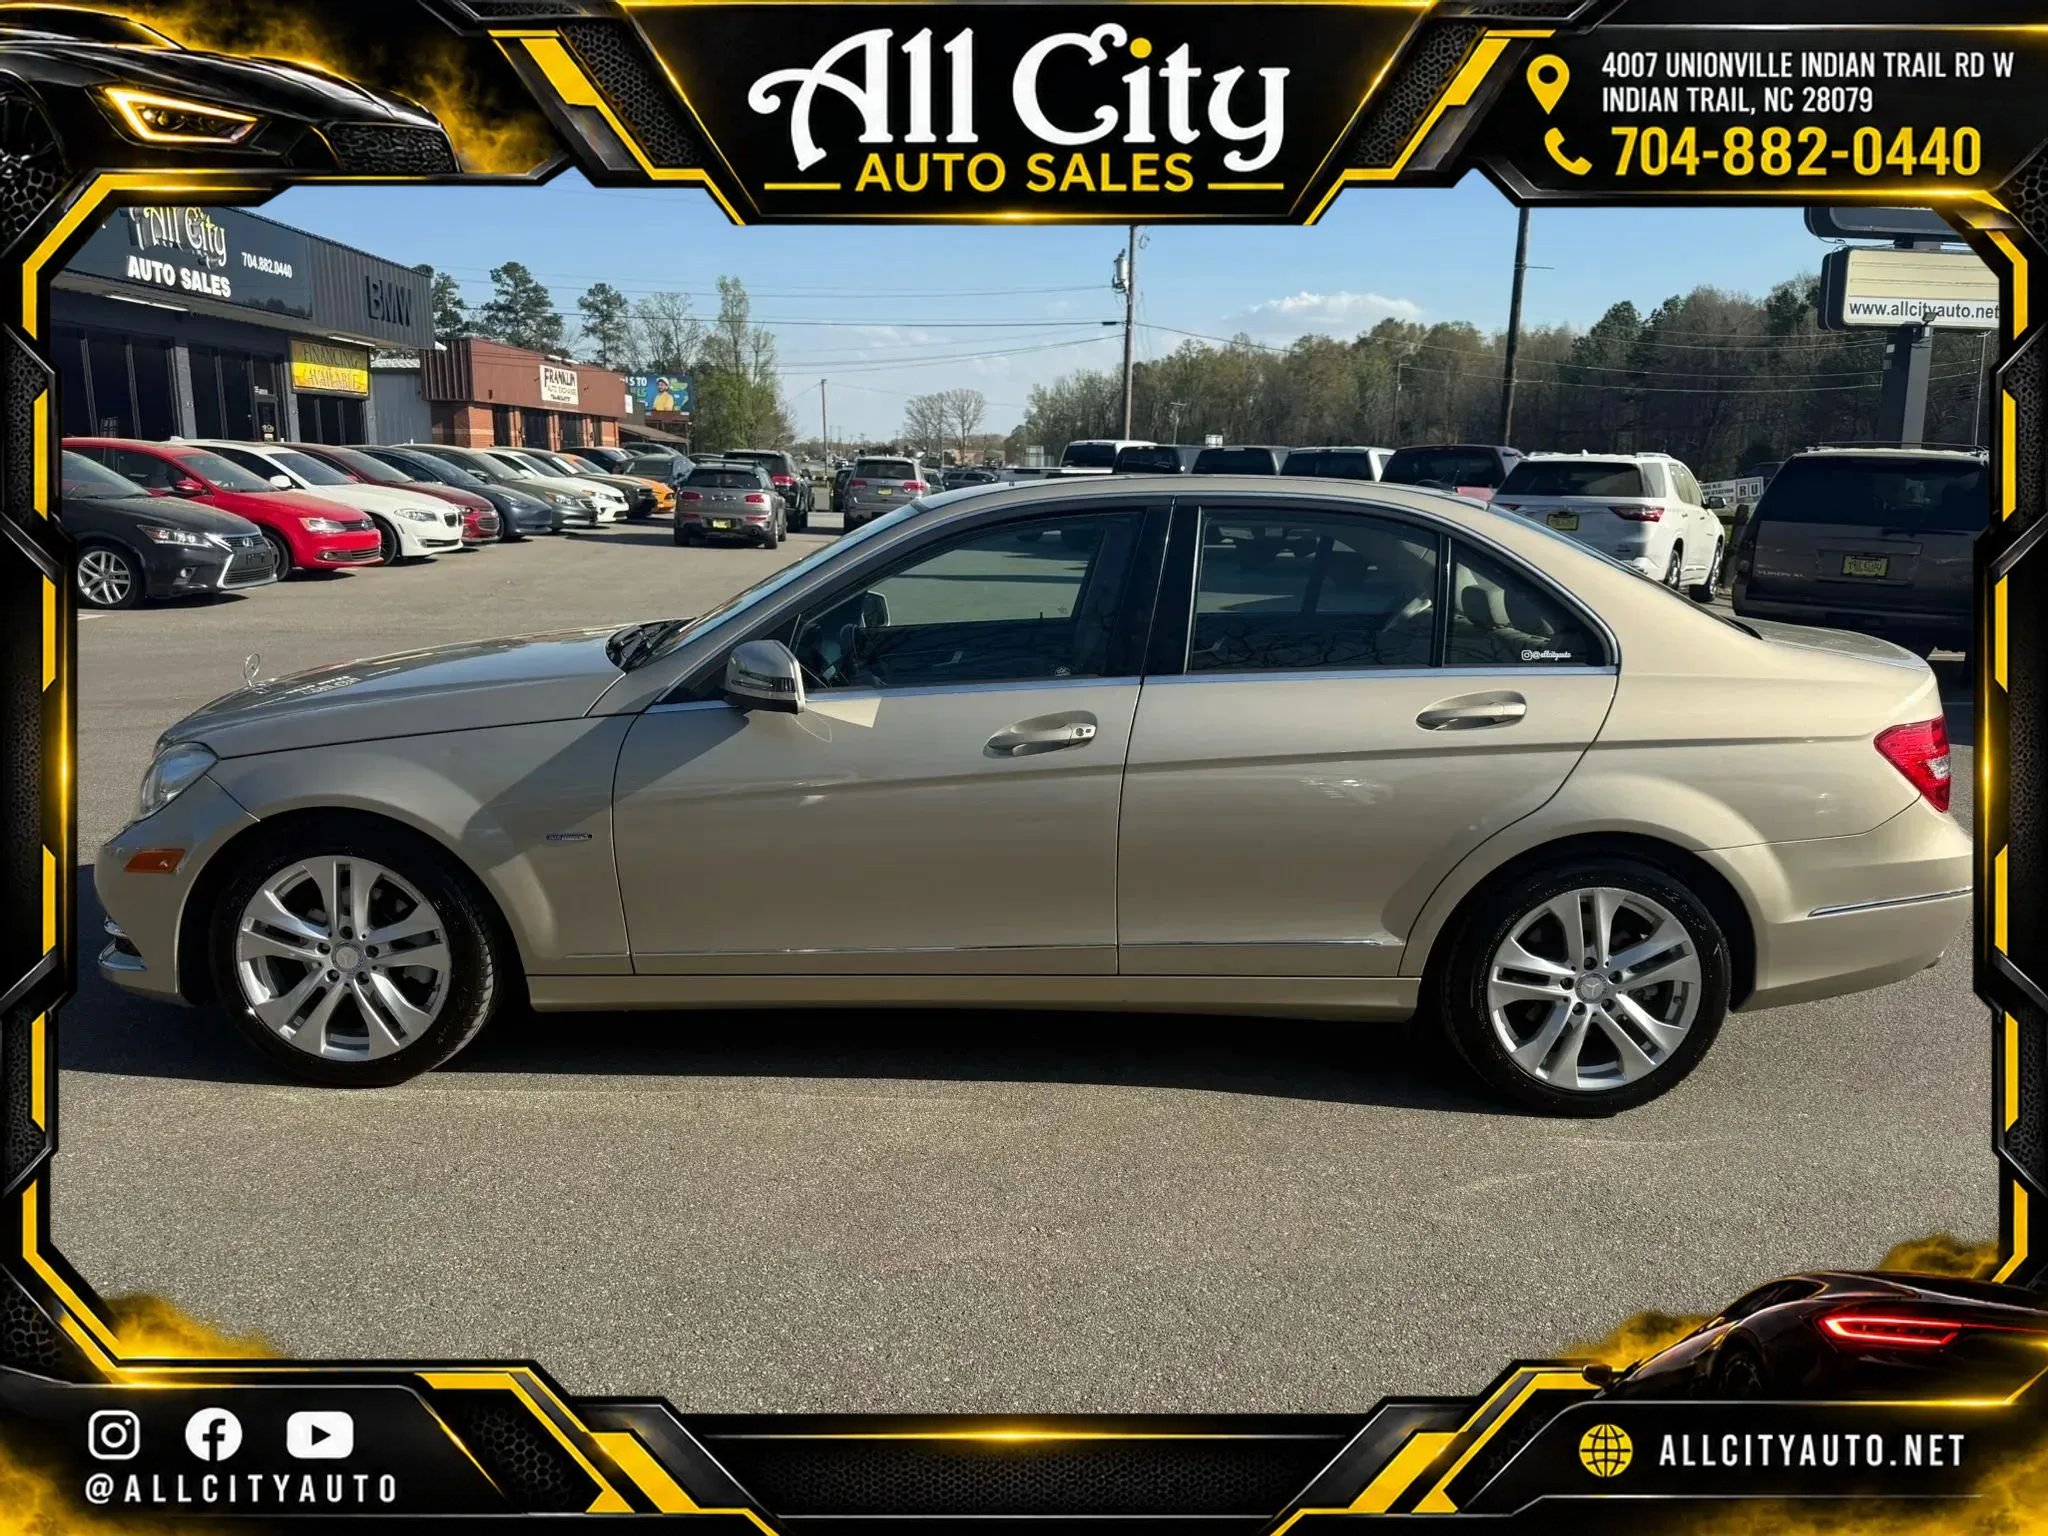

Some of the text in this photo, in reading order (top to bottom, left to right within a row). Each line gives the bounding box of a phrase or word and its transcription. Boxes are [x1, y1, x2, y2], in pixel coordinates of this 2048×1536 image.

[184, 207, 227, 267] City
[127, 256, 231, 298] AUTO SALES
[241, 252, 293, 279] 704.882.0440
[366, 275, 411, 327] BMW
[303, 343, 359, 369] FINANCING
[306, 366, 359, 391] AVAILABLE
[544, 367, 576, 387] FRANKLIN
